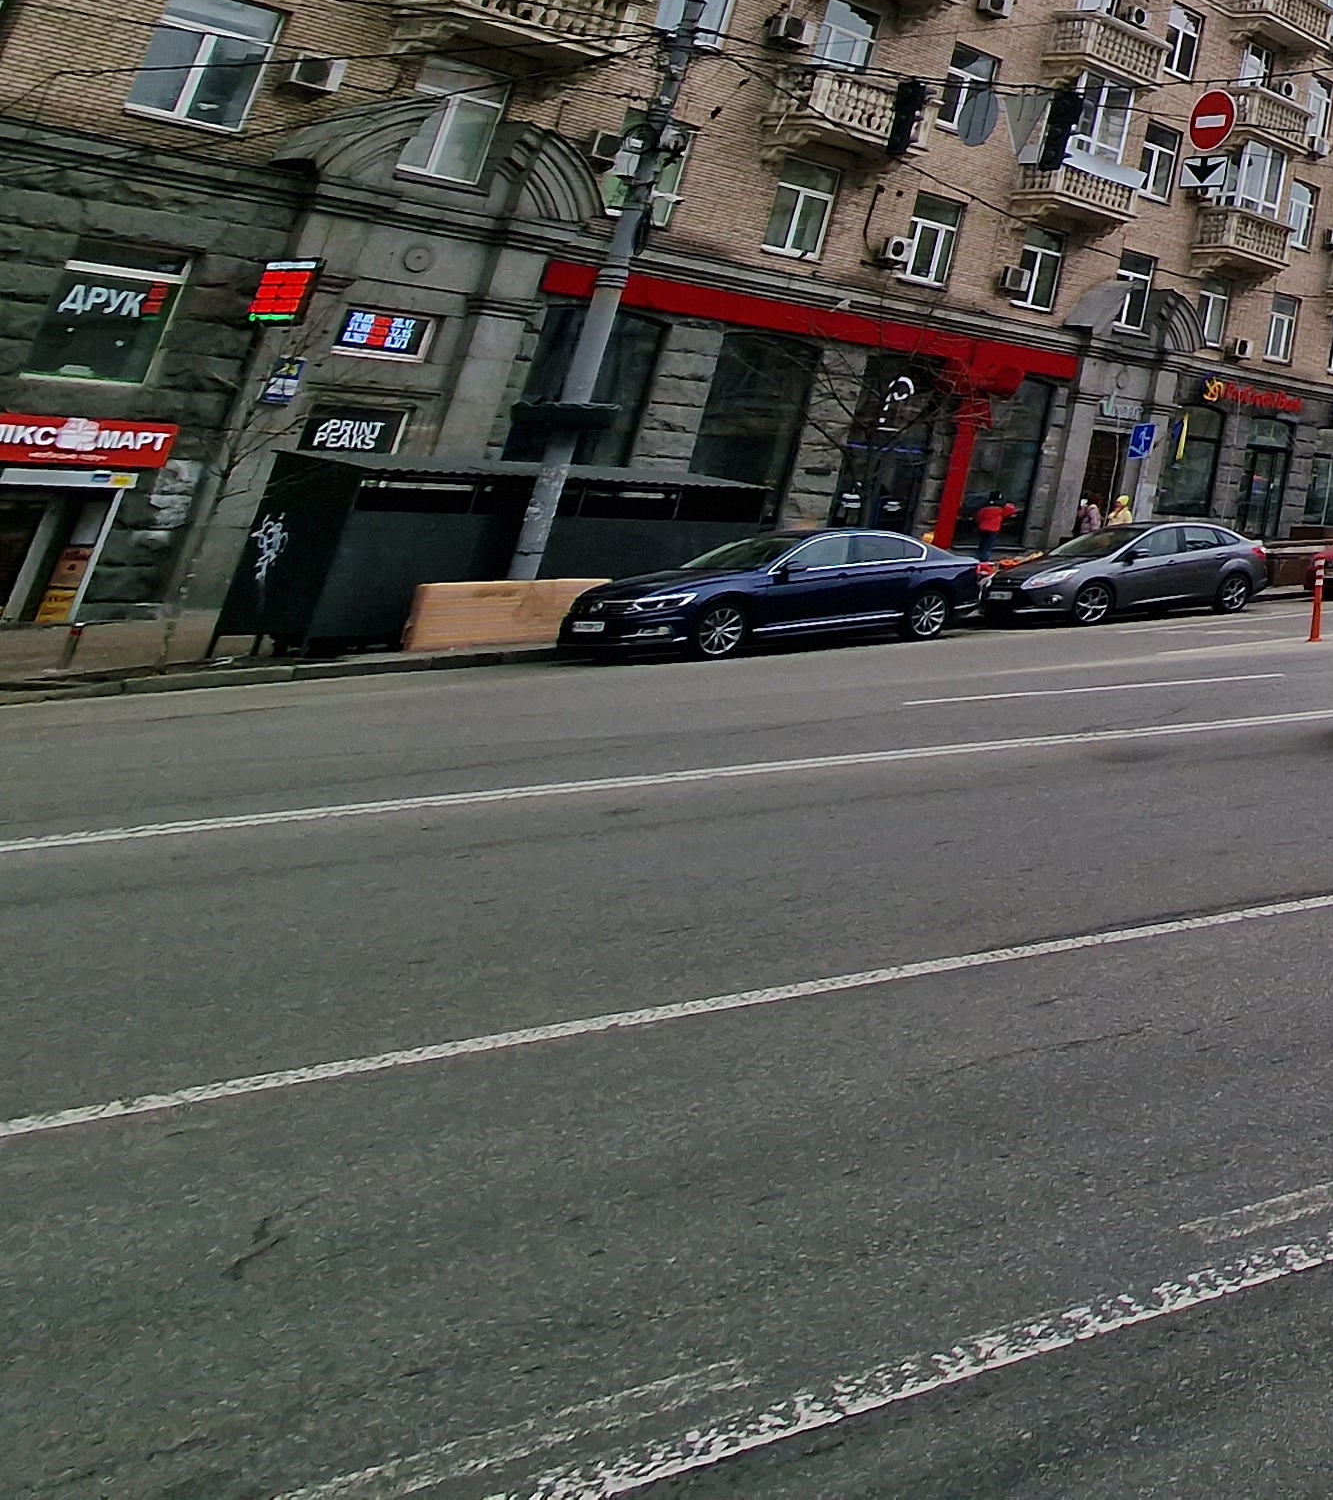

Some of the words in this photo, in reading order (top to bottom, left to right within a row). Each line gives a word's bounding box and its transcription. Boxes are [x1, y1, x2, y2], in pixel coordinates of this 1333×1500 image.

[56, 284, 148, 319] ДРУК
[319, 419, 386, 438] PRINT
[97, 430, 171, 451] МАРТ
[312, 432, 376, 450] PEAKS
